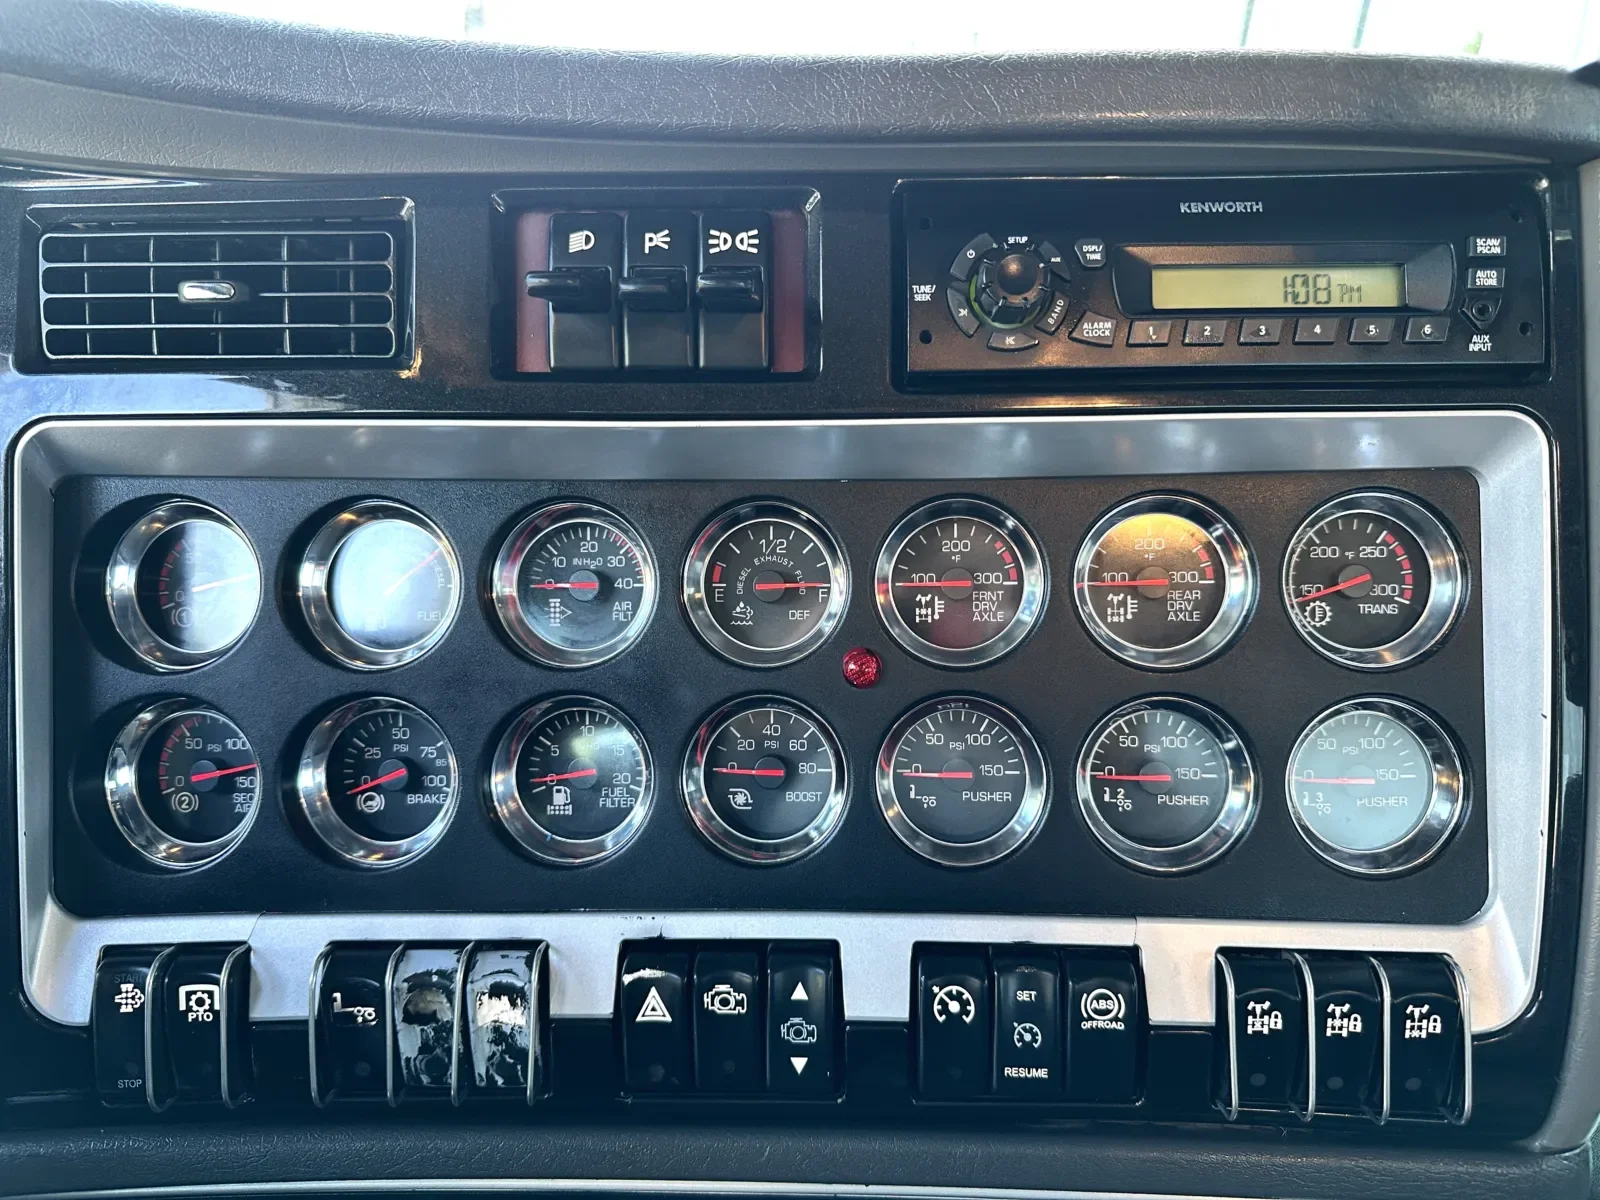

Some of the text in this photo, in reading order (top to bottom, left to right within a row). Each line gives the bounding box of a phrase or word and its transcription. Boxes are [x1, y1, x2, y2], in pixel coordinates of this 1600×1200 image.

[1179, 201, 1263, 213] KENWORTH
[1007, 236, 1030, 245] SETUP
[1476, 238, 1500, 246] SCAN/
[1476, 246, 1501, 254] PSCAN
[1475, 270, 1497, 278] AUTO
[1475, 278, 1498, 286] STORE
[911, 284, 936, 294] TUNE/
[1338, 283, 1362, 303] PM
[914, 294, 932, 302] SEEK
[1047, 299, 1064, 325] BAND
[1083, 321, 1112, 329] ALARM
[1314, 325, 1321, 335] 4
[1369, 325, 1376, 335] 5
[1424, 325, 1431, 335] 6
[1083, 329, 1111, 337] CLOCK
[1203, 326, 1211, 336] 2
[1259, 326, 1266, 336] 3
[1471, 334, 1490, 344] AUX
[1468, 344, 1492, 352] INPUT
[580, 541, 598, 553] 20
[759, 538, 787, 555] 1/2
[941, 540, 971, 552] 200
[1134, 538, 1165, 550] 200
[1310, 546, 1339, 558] 200
[1359, 546, 1387, 558] 250
[552, 556, 566, 568] 10
[607, 556, 625, 567] 30
[736, 567, 752, 595] DIESEL
[753, 555, 794, 569] EXHAUST
[910, 573, 936, 585] 100
[973, 572, 1003, 584] 300
[1101, 572, 1128, 583] 100
[1169, 571, 1198, 583] 300
[614, 578, 633, 590] 40
[714, 588, 724, 602] E
[818, 588, 829, 603] F
[1167, 590, 1201, 600] REAR
[1299, 584, 1324, 596] 150
[1369, 584, 1399, 596] 300
[972, 591, 1005, 601] FRNT
[613, 601, 632, 611] AIR
[972, 601, 998, 611] DRV
[1167, 601, 1194, 611] DRV
[1357, 603, 1398, 615] TRANS
[612, 611, 633, 622] FILT
[788, 610, 811, 620] DEF
[972, 612, 1005, 622] AXLE
[1167, 611, 1201, 622] AXLE
[392, 727, 410, 739] 50
[580, 725, 595, 737] 10
[762, 725, 781, 736] 40
[184, 737, 203, 750] 50
[225, 738, 250, 750] 100
[737, 740, 755, 750] 20
[764, 741, 780, 749] PSI
[925, 734, 944, 745] 50
[965, 734, 991, 745] 100
[1119, 736, 1139, 747] 50
[1160, 736, 1188, 748] 100
[1317, 738, 1337, 750] 50
[1359, 737, 1385, 749] 100
[207, 744, 223, 753] PSI
[393, 744, 409, 752] PSI
[551, 745, 560, 757] 5
[611, 745, 625, 756] 15
[789, 740, 807, 751] 60
[950, 742, 965, 750] PSI
[1144, 744, 1161, 752] PSI
[1342, 746, 1359, 755] PSI
[364, 747, 381, 759] 25
[420, 746, 437, 758] 75
[435, 759, 448, 767] 85
[728, 762, 738, 772] 0
[799, 763, 817, 774] 80
[912, 764, 922, 774] 0
[979, 765, 1004, 776] 150
[1105, 766, 1115, 776] 0
[1175, 768, 1201, 780] 150
[1304, 769, 1314, 779] 0
[1375, 769, 1399, 780] 150
[175, 776, 185, 787] 0
[234, 776, 257, 788] 150
[361, 775, 371, 786] 0
[421, 775, 447, 787] 100
[612, 773, 631, 785] 20
[602, 787, 630, 797] FUEL
[786, 792, 822, 802] BOOST
[962, 791, 1012, 802] PUSHER
[407, 793, 448, 804] BRAKE
[600, 798, 636, 808] FILTER
[1158, 795, 1209, 806] PUSHER
[1356, 796, 1408, 807] PUSHER
[114, 973, 144, 983] START
[1016, 990, 1036, 1002] SET
[1090, 999, 1114, 1010] ABS
[188, 1012, 214, 1022] PTO
[1081, 1020, 1125, 1030] OFFROAD
[1004, 1067, 1048, 1078] RESUME
[117, 1079, 142, 1088] STOP
